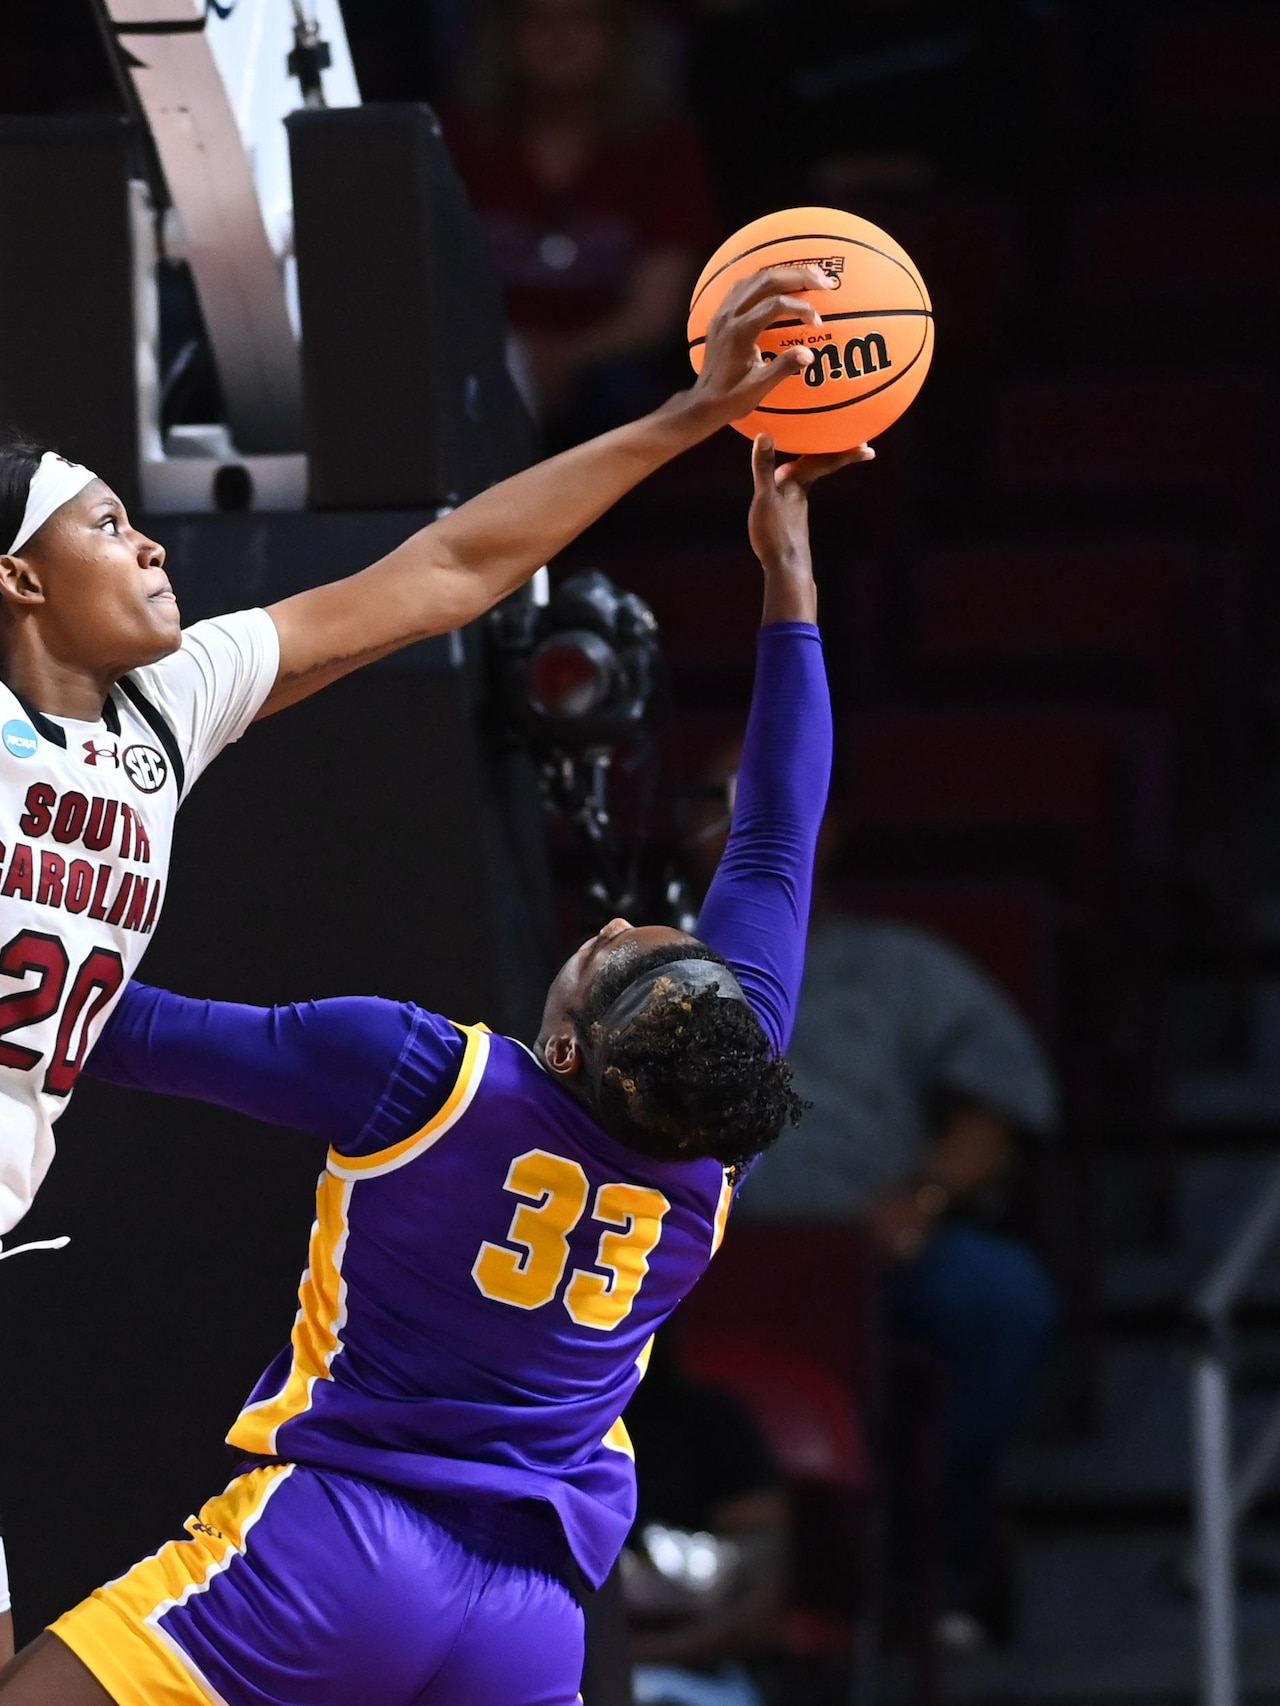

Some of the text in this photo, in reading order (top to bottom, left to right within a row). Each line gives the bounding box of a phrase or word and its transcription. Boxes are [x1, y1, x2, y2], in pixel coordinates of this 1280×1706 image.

[761, 332, 892, 387] Wil
[779, 333, 832, 347] EVO NXT
[7, 734, 37, 750] NCAA
[124, 745, 166, 790] SEC
[19, 782, 151, 863] SOUTH
[471, 1148, 672, 1331] 33
